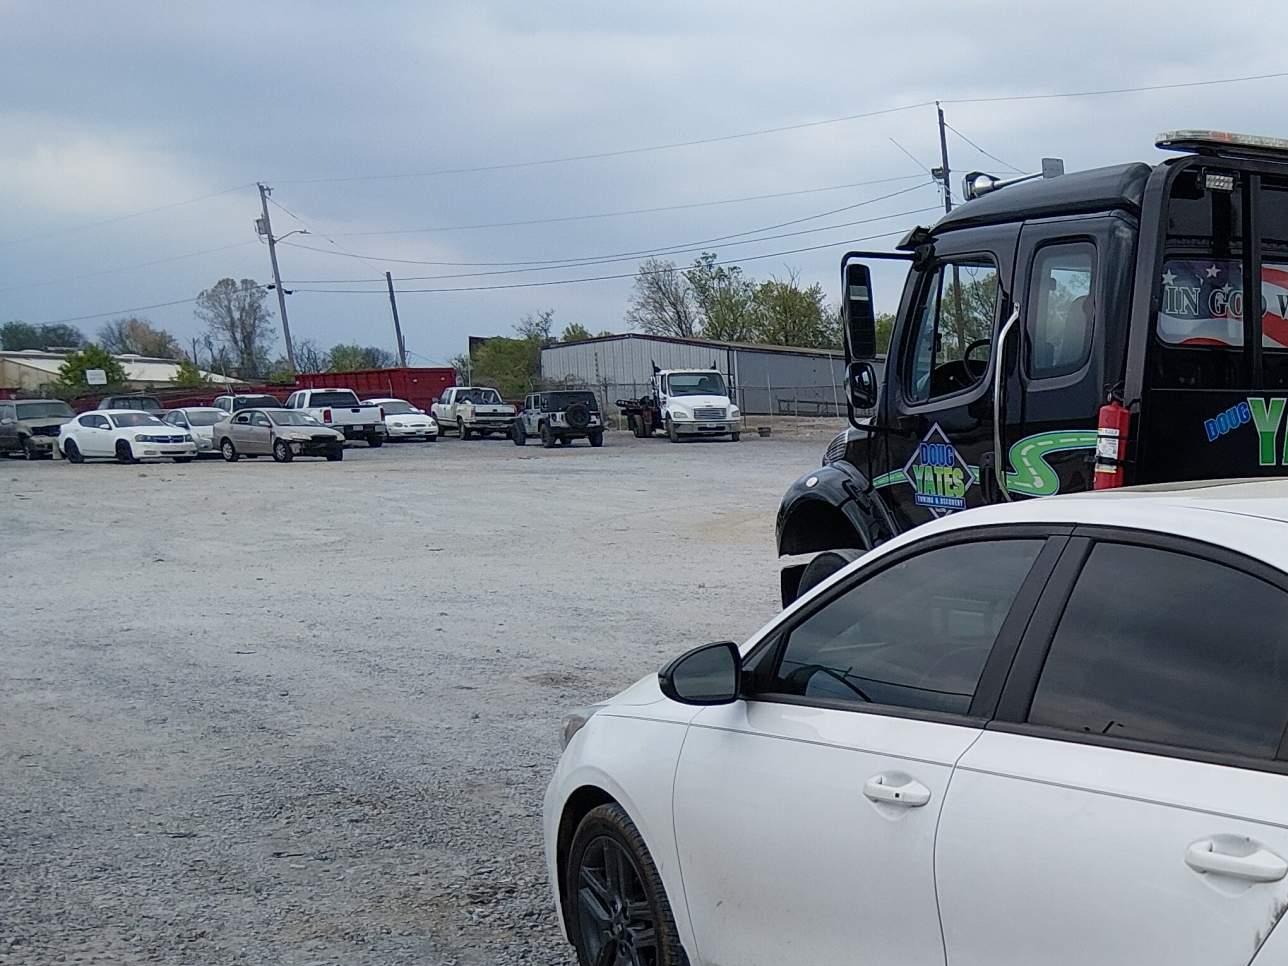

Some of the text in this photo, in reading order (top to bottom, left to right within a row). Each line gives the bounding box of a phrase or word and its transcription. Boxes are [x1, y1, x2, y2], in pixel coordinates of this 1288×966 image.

[1165, 286, 1200, 315] IN
[1208, 288, 1267, 317] GO
[1204, 401, 1252, 442] DOUG
[920, 442, 955, 467] DOUG
[912, 465, 965, 496] YATES
